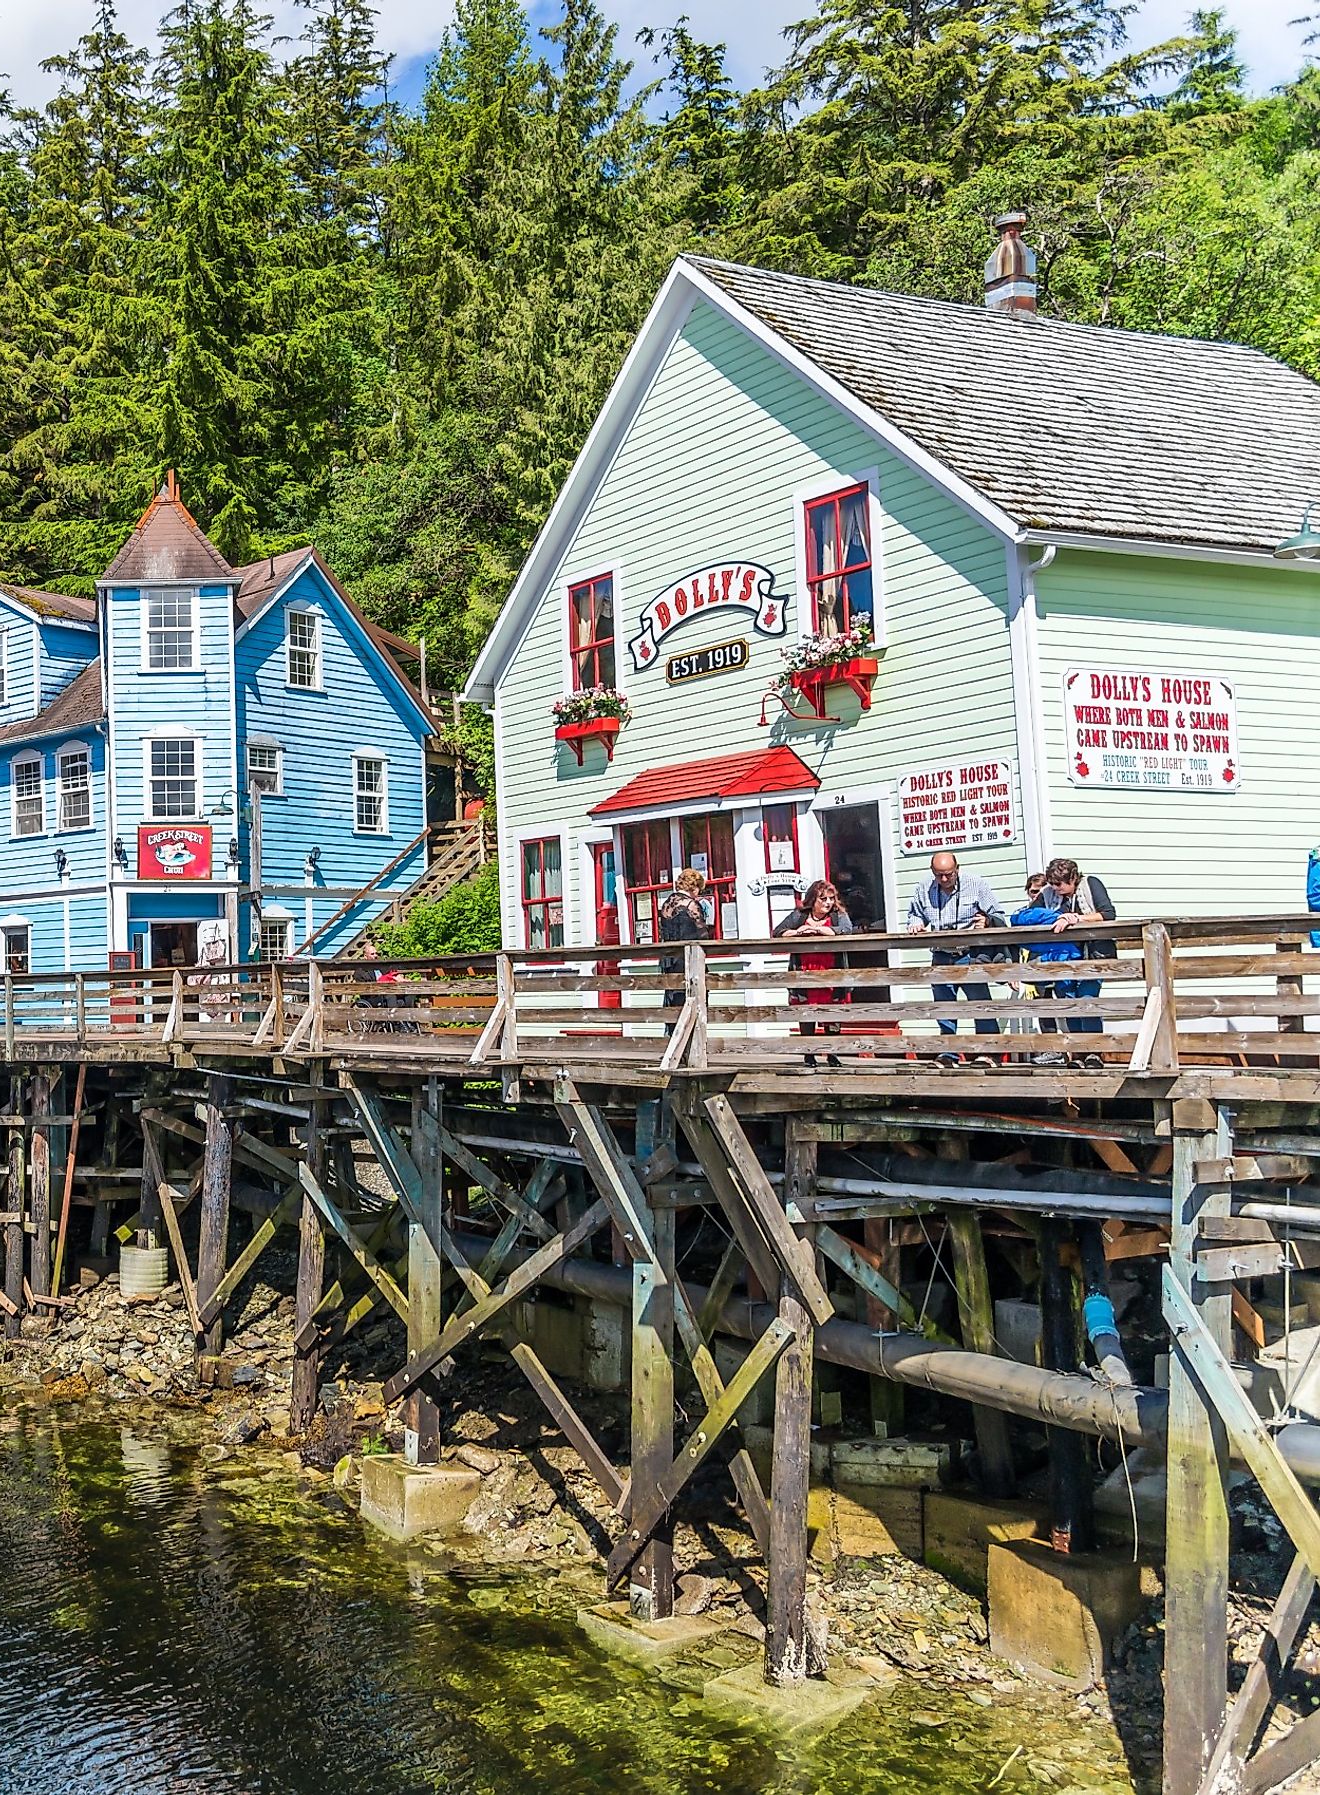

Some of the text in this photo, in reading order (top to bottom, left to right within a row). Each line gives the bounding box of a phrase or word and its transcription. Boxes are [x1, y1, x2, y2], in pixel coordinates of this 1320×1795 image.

[655, 566, 756, 630] DOLLY'S
[671, 644, 742, 678] EST. 1919
[1090, 674, 1212, 705] DOLLY'S HOUSE
[1074, 705, 1229, 730] WHERE BOTH MEN & SALMON
[1076, 728, 1229, 753] CAME UPSTREAM TO SPAWN
[1102, 754, 1136, 767] HISTORIC
[1190, 758, 1208, 770] TOUR
[910, 763, 998, 792] DOLLY'S HOUSE
[1116, 770, 1140, 783] CREEK
[1143, 772, 1170, 784] STREET
[1196, 774, 1212, 785] 1919
[834, 795, 845, 805] 24
[903, 783, 1008, 809] HISTORIC RED LIGHT TOUR
[903, 800, 1009, 824] WHERE BOTH MEN & SALMON
[148, 830, 203, 845] CREEK STREET
[904, 814, 1009, 837] CAME UPSTREAM TO SPAWN
[945, 835, 966, 845] STREET
